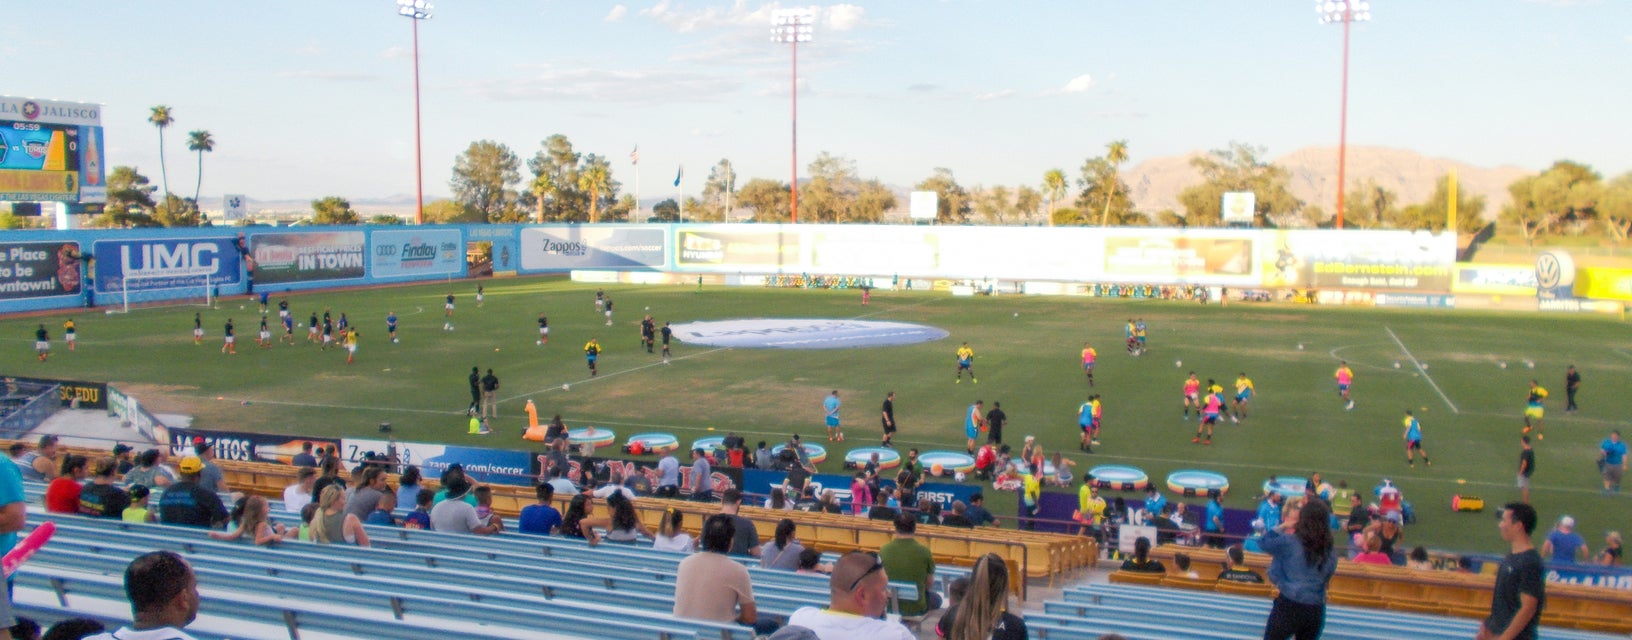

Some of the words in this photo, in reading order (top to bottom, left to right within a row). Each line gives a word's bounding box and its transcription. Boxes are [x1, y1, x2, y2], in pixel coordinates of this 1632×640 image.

[42, 105, 97, 120] JALISCO
[13, 122, 40, 131] 05:59
[69, 141, 77, 151] 0
[10, 247, 47, 261] Place
[402, 243, 438, 260] Findlay
[543, 238, 581, 255] Zappos
[120, 242, 220, 276] UMC
[298, 254, 316, 270] IN
[317, 252, 362, 269] TOWN
[15, 263, 33, 277] be
[172, 433, 249, 461] JAITOS
[917, 491, 954, 508] FIRST
